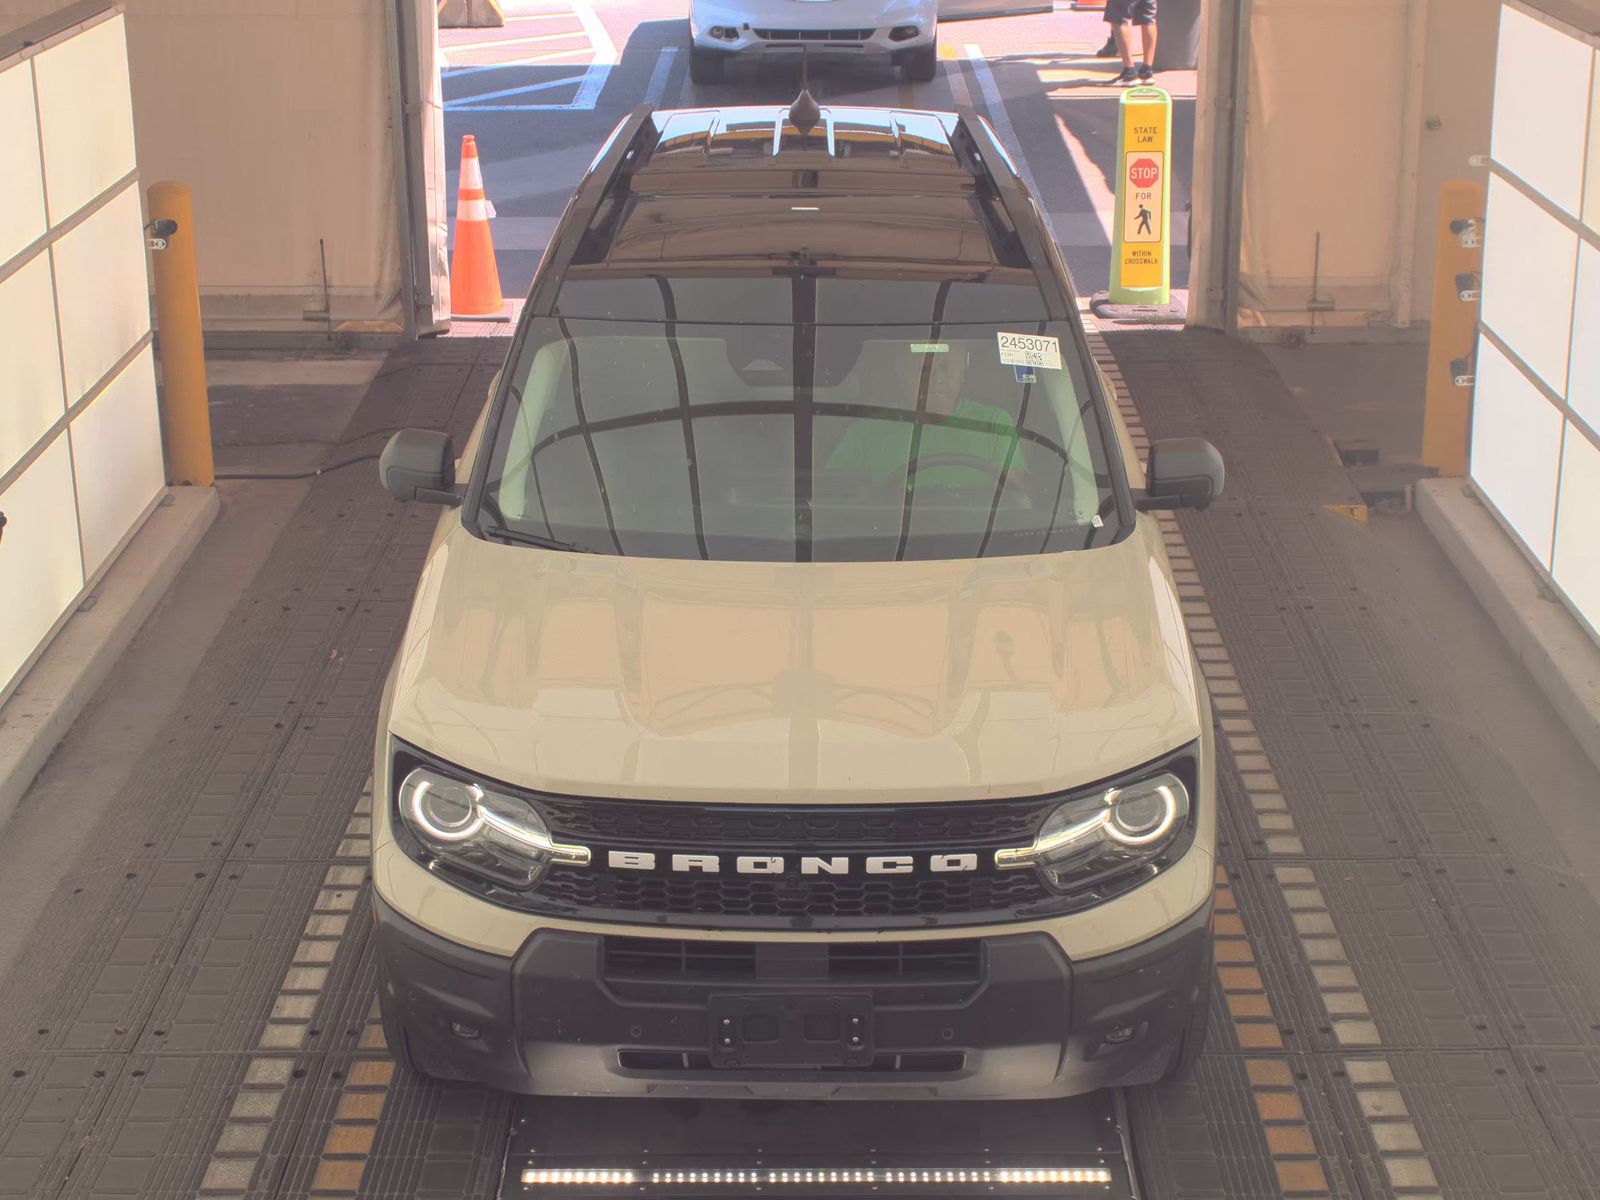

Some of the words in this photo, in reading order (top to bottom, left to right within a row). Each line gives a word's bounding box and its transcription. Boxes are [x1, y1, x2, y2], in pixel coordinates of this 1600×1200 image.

[1133, 126, 1159, 135] STATE
[1130, 167, 1158, 179] STOP
[1135, 192, 1152, 200] FOR
[1000, 335, 1058, 353] 2453071
[608, 850, 978, 874] BRONCO
